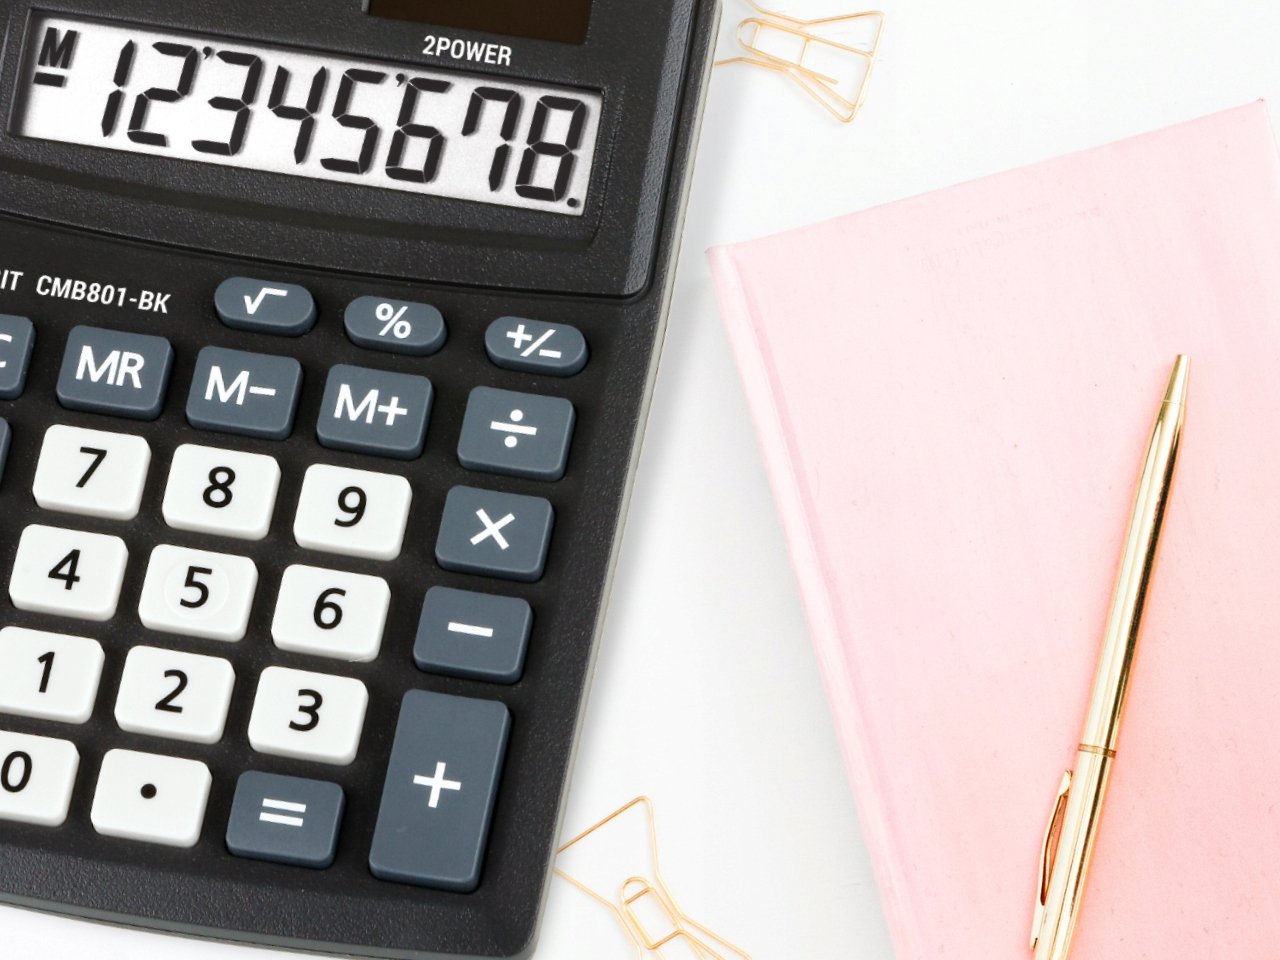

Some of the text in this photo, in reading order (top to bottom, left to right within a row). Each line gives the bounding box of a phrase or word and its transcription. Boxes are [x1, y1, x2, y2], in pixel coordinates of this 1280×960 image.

[37, 26, 79, 70] M
[422, 34, 512, 66] 2POWER
[75, 345, 145, 389] MR
[75, 446, 108, 488] 7
[202, 466, 236, 509] 8
[334, 486, 367, 528] 9
[47, 549, 81, 591] 4
[179, 565, 213, 609] 5
[313, 587, 346, 630] 6
[37, 651, 55, 693] 1
[154, 669, 188, 714] 2
[288, 688, 323, 732] 3
[0, 750, 33, 793] 0
